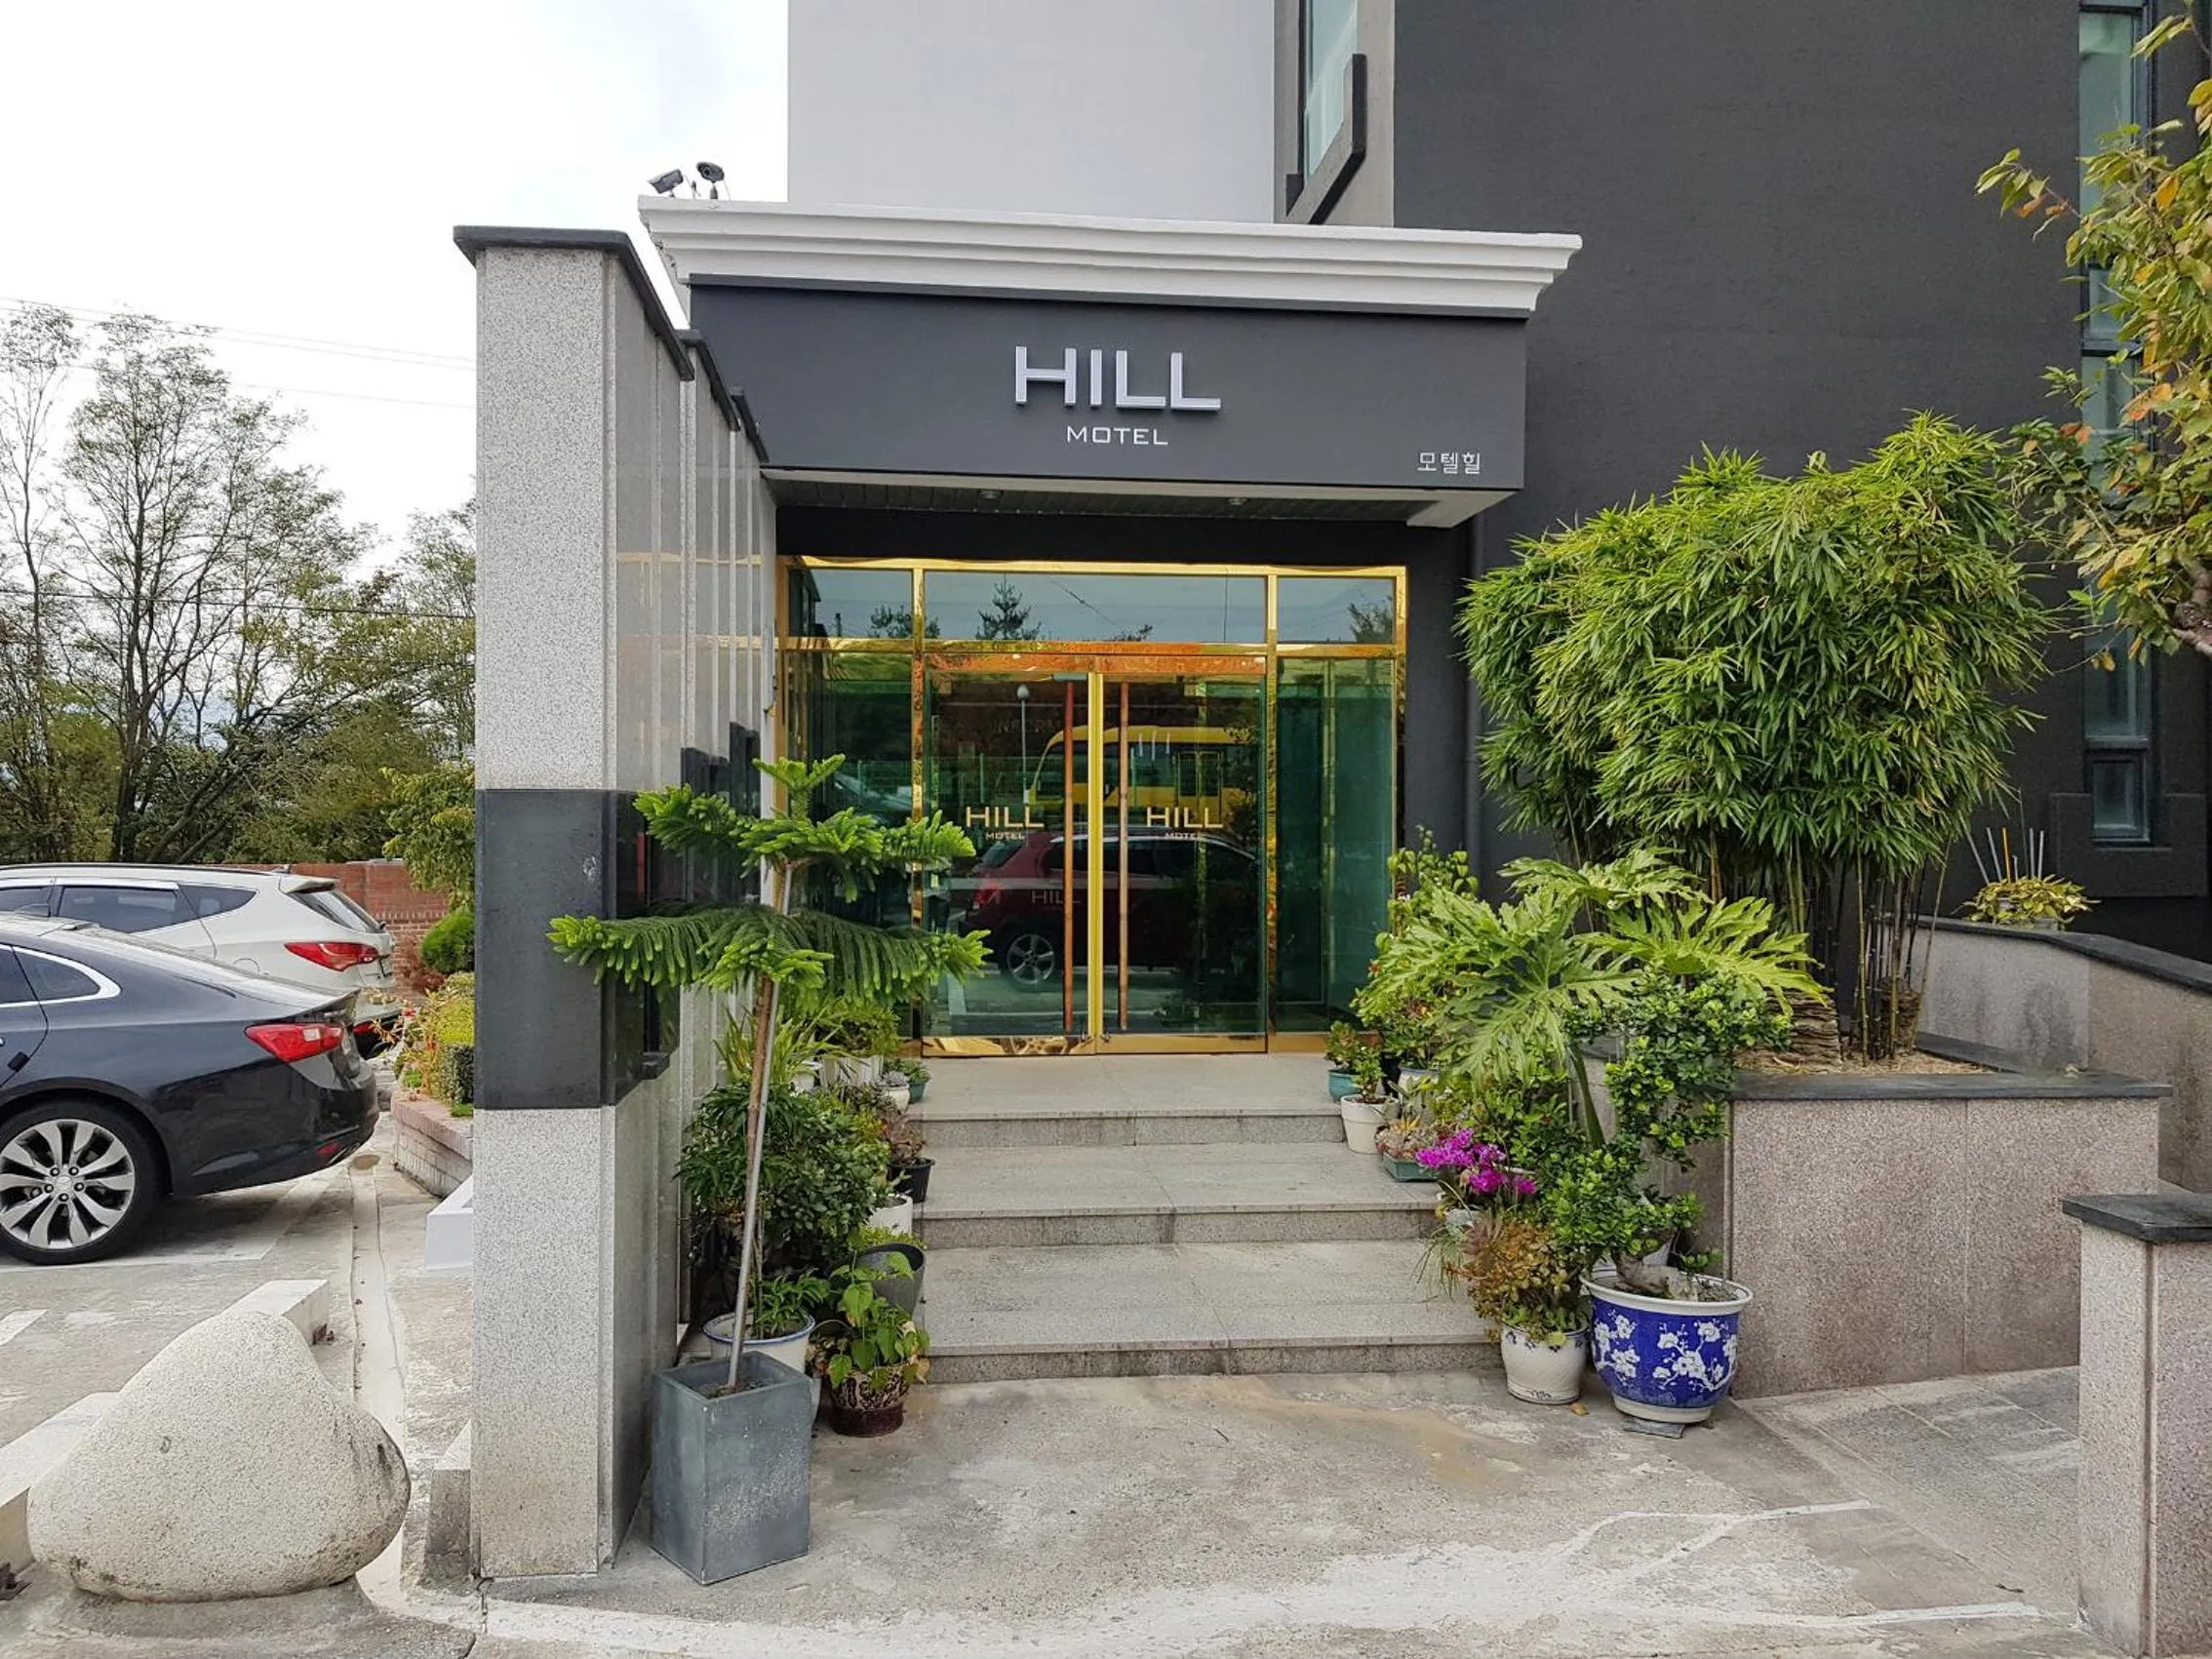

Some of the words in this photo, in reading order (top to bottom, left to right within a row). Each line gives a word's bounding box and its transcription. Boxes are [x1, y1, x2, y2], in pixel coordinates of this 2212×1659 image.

[1015, 345, 1221, 410] HILL
[1067, 425, 1168, 446] MOTEL
[1417, 452, 1480, 474] 모텔힐
[966, 806, 1045, 828] HILL
[1147, 807, 1223, 828] HILL
[985, 831, 1025, 840] MOTEL
